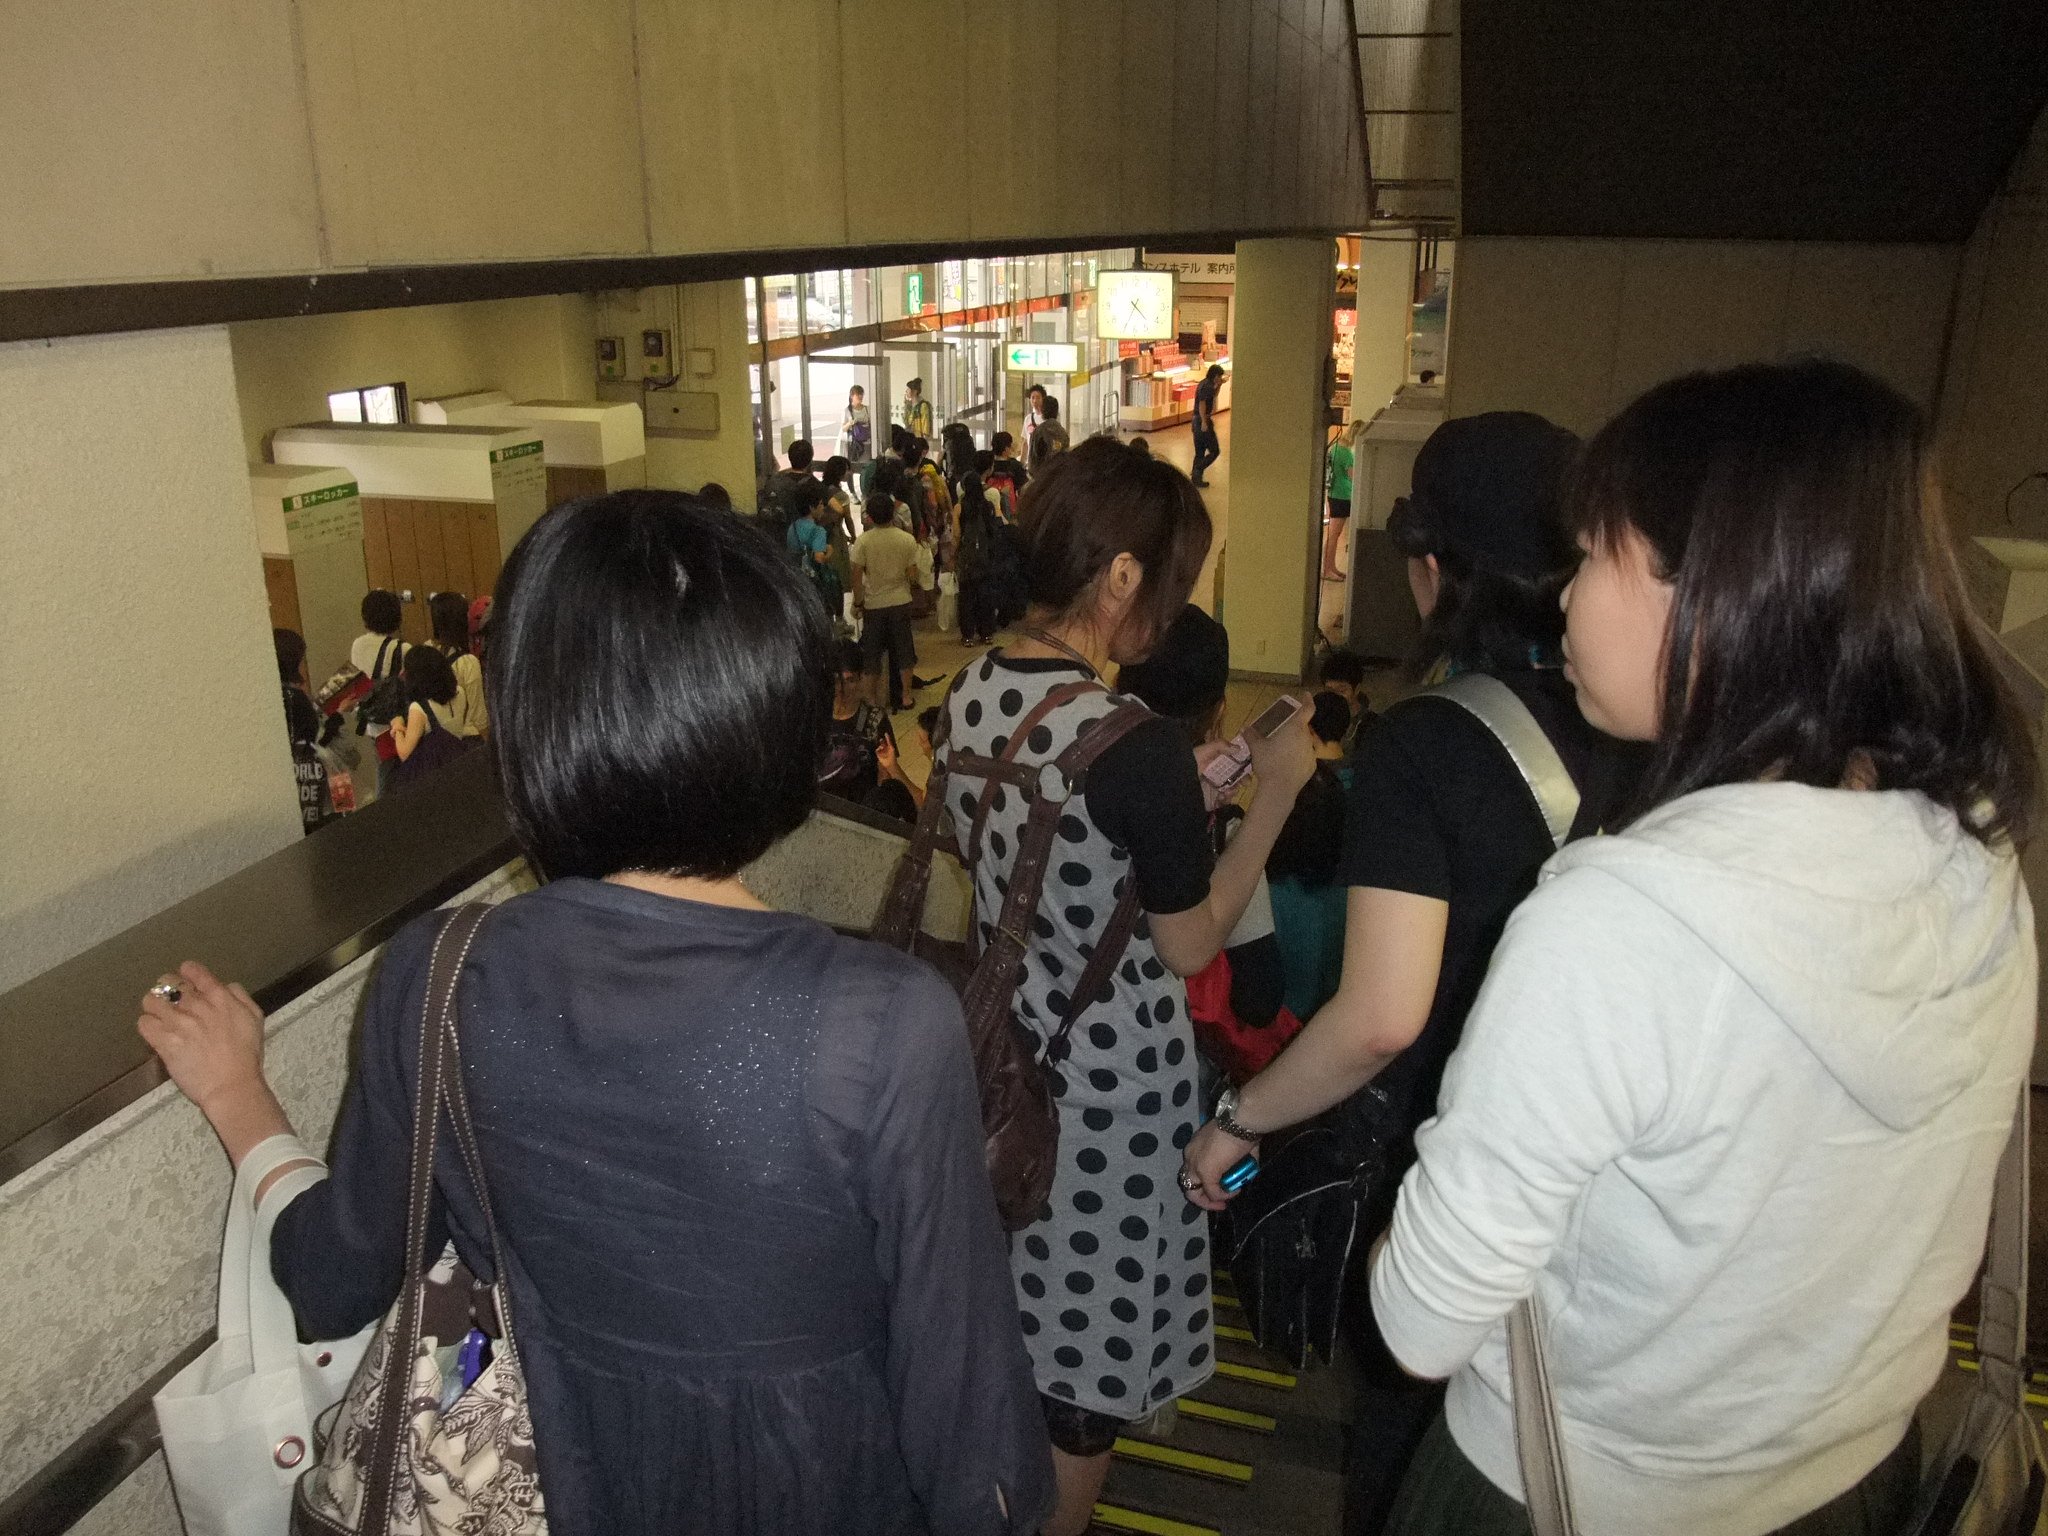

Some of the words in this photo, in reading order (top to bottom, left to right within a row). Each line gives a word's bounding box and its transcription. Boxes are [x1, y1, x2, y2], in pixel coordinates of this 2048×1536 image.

[303, 489, 349, 504] スキーロッカー
